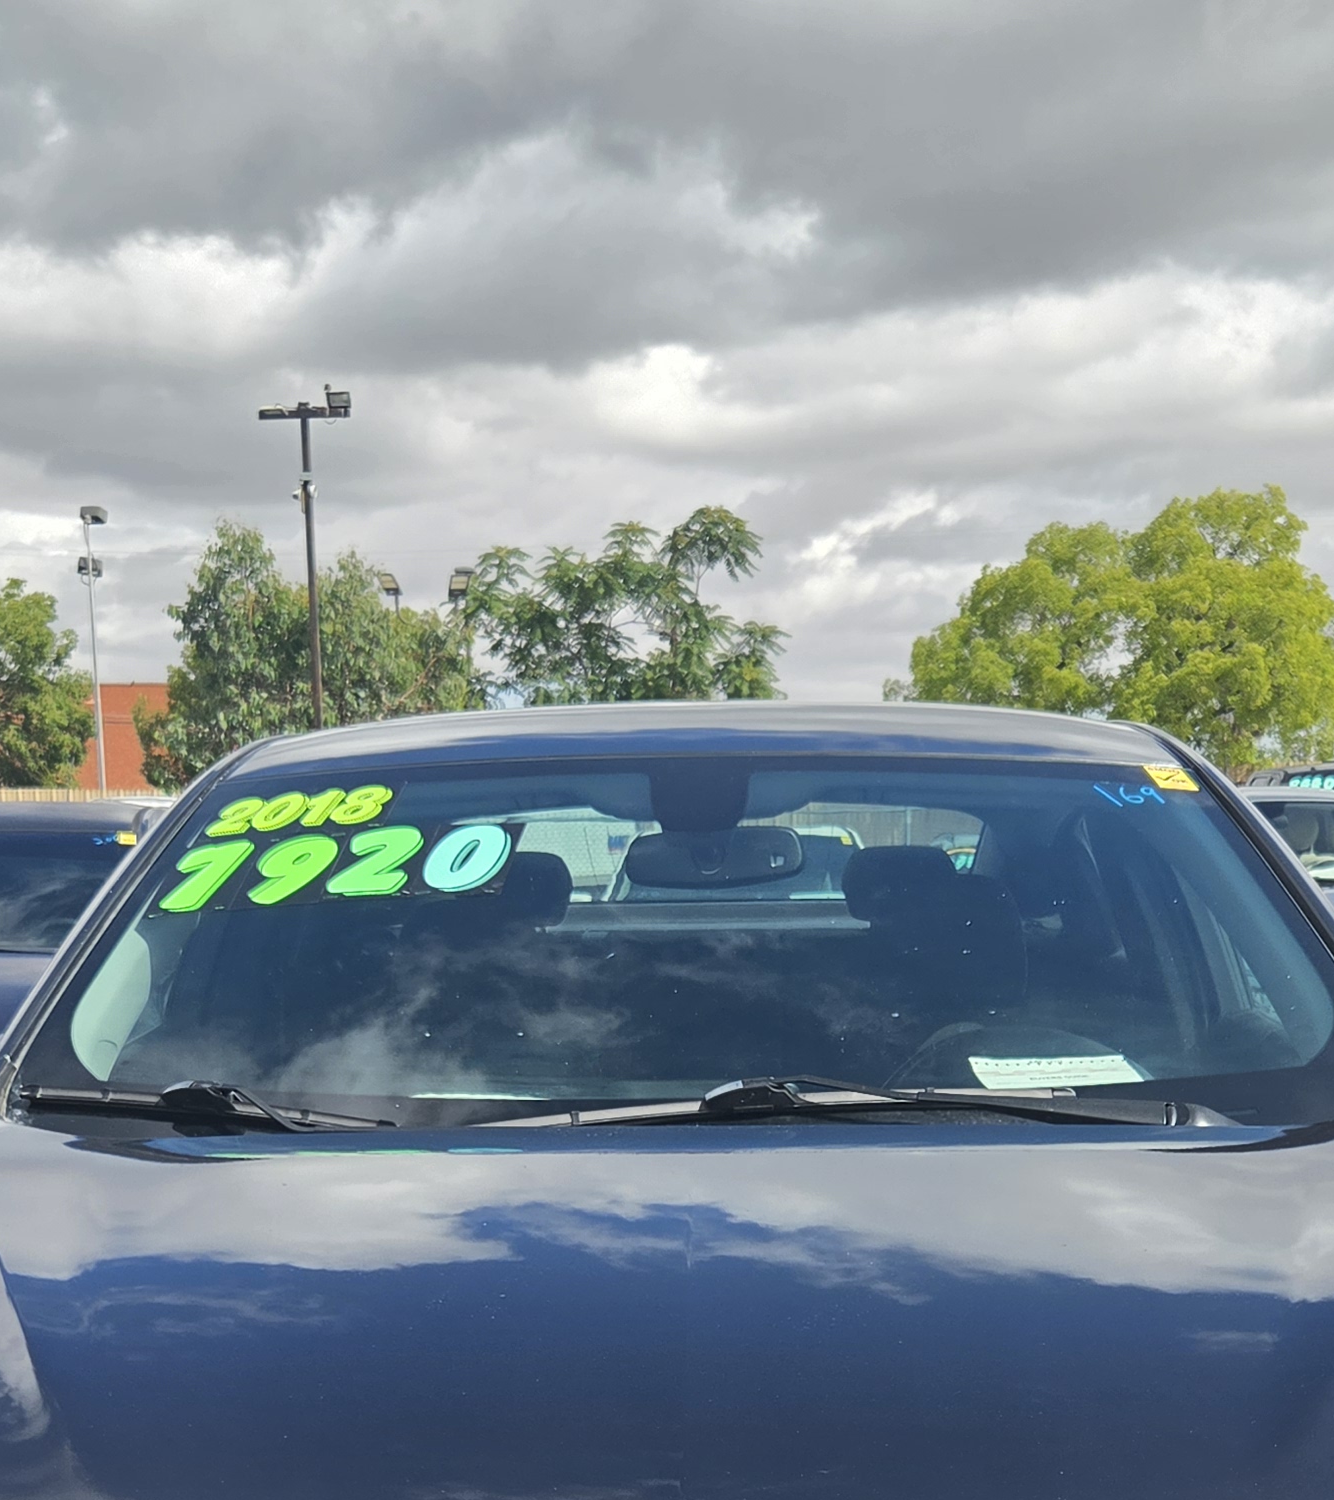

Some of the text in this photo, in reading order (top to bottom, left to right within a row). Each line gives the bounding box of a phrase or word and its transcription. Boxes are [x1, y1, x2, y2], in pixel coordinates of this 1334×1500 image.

[205, 784, 393, 837] 2018
[1093, 784, 1165, 807] 169
[159, 824, 511, 912] 7920
